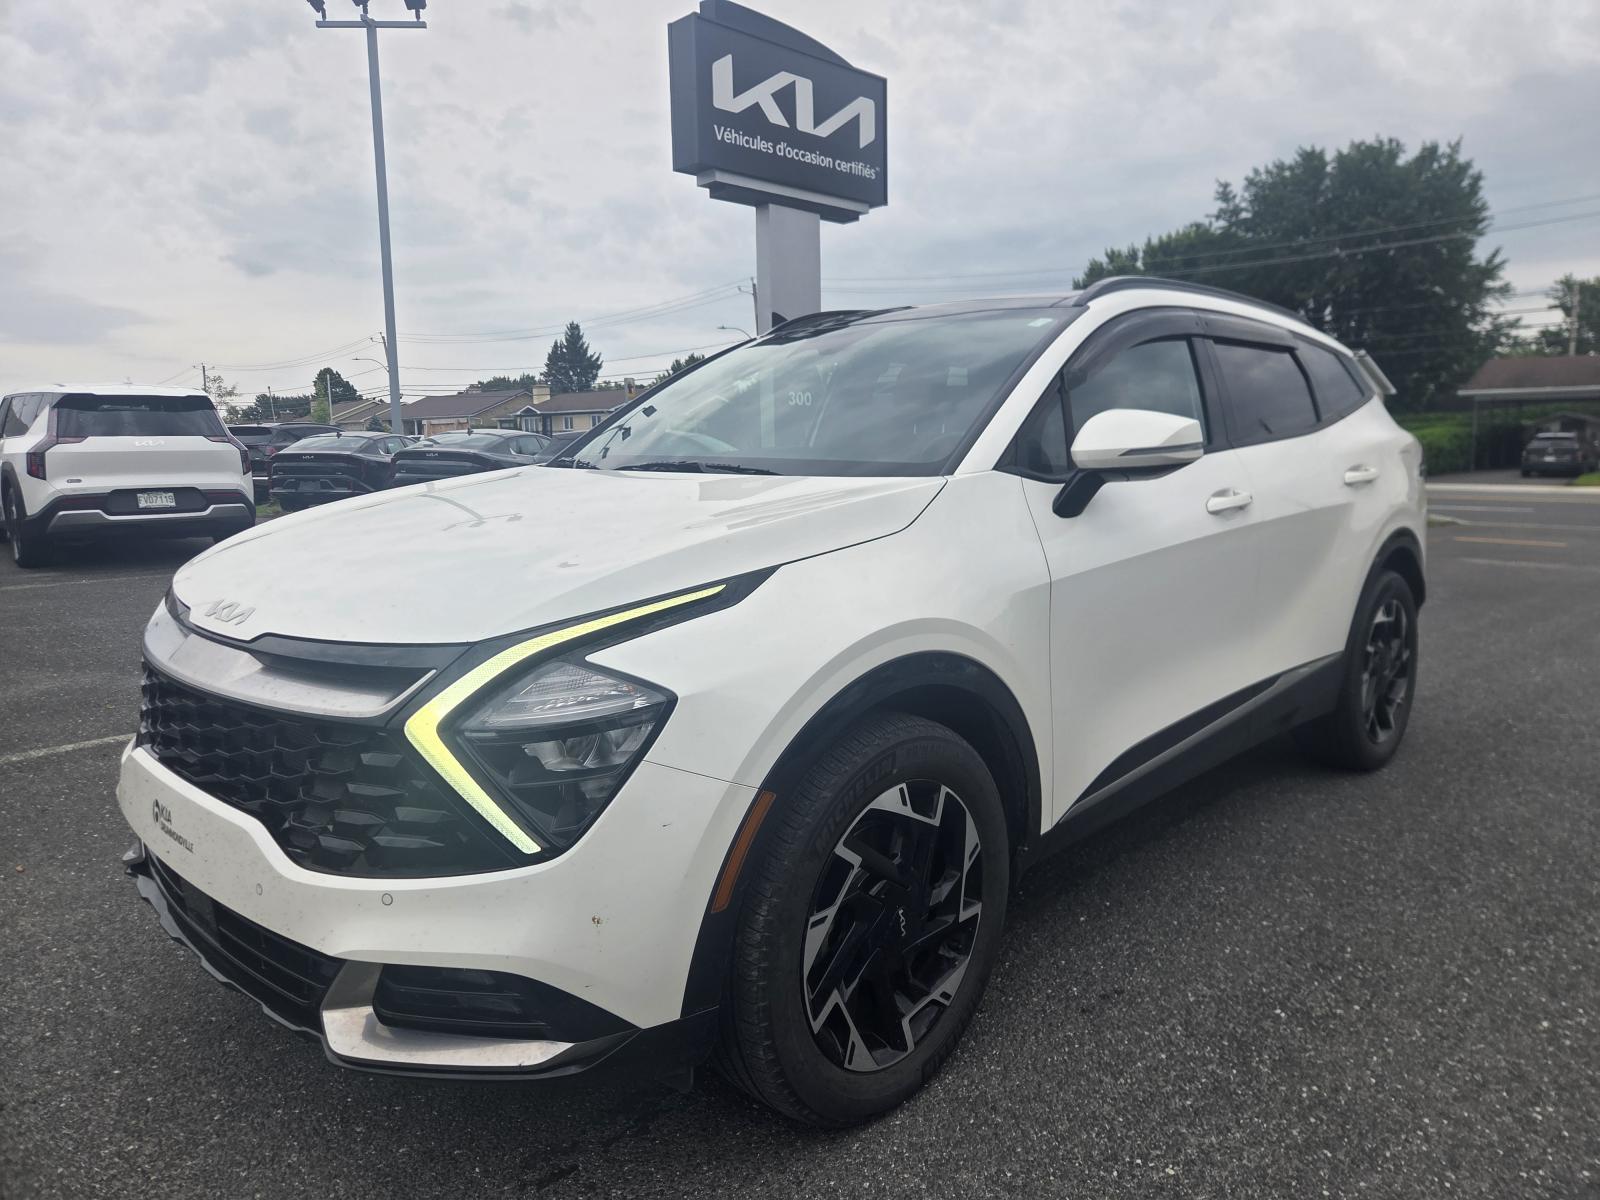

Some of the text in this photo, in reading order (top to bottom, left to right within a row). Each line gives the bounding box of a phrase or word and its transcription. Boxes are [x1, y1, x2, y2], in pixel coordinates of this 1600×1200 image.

[712, 54, 875, 149] KIA
[714, 124, 876, 179] Véhicules d'occasion certifiés
[789, 391, 811, 406] 300
[204, 599, 256, 626] KIA
[160, 803, 172, 825] KIA
